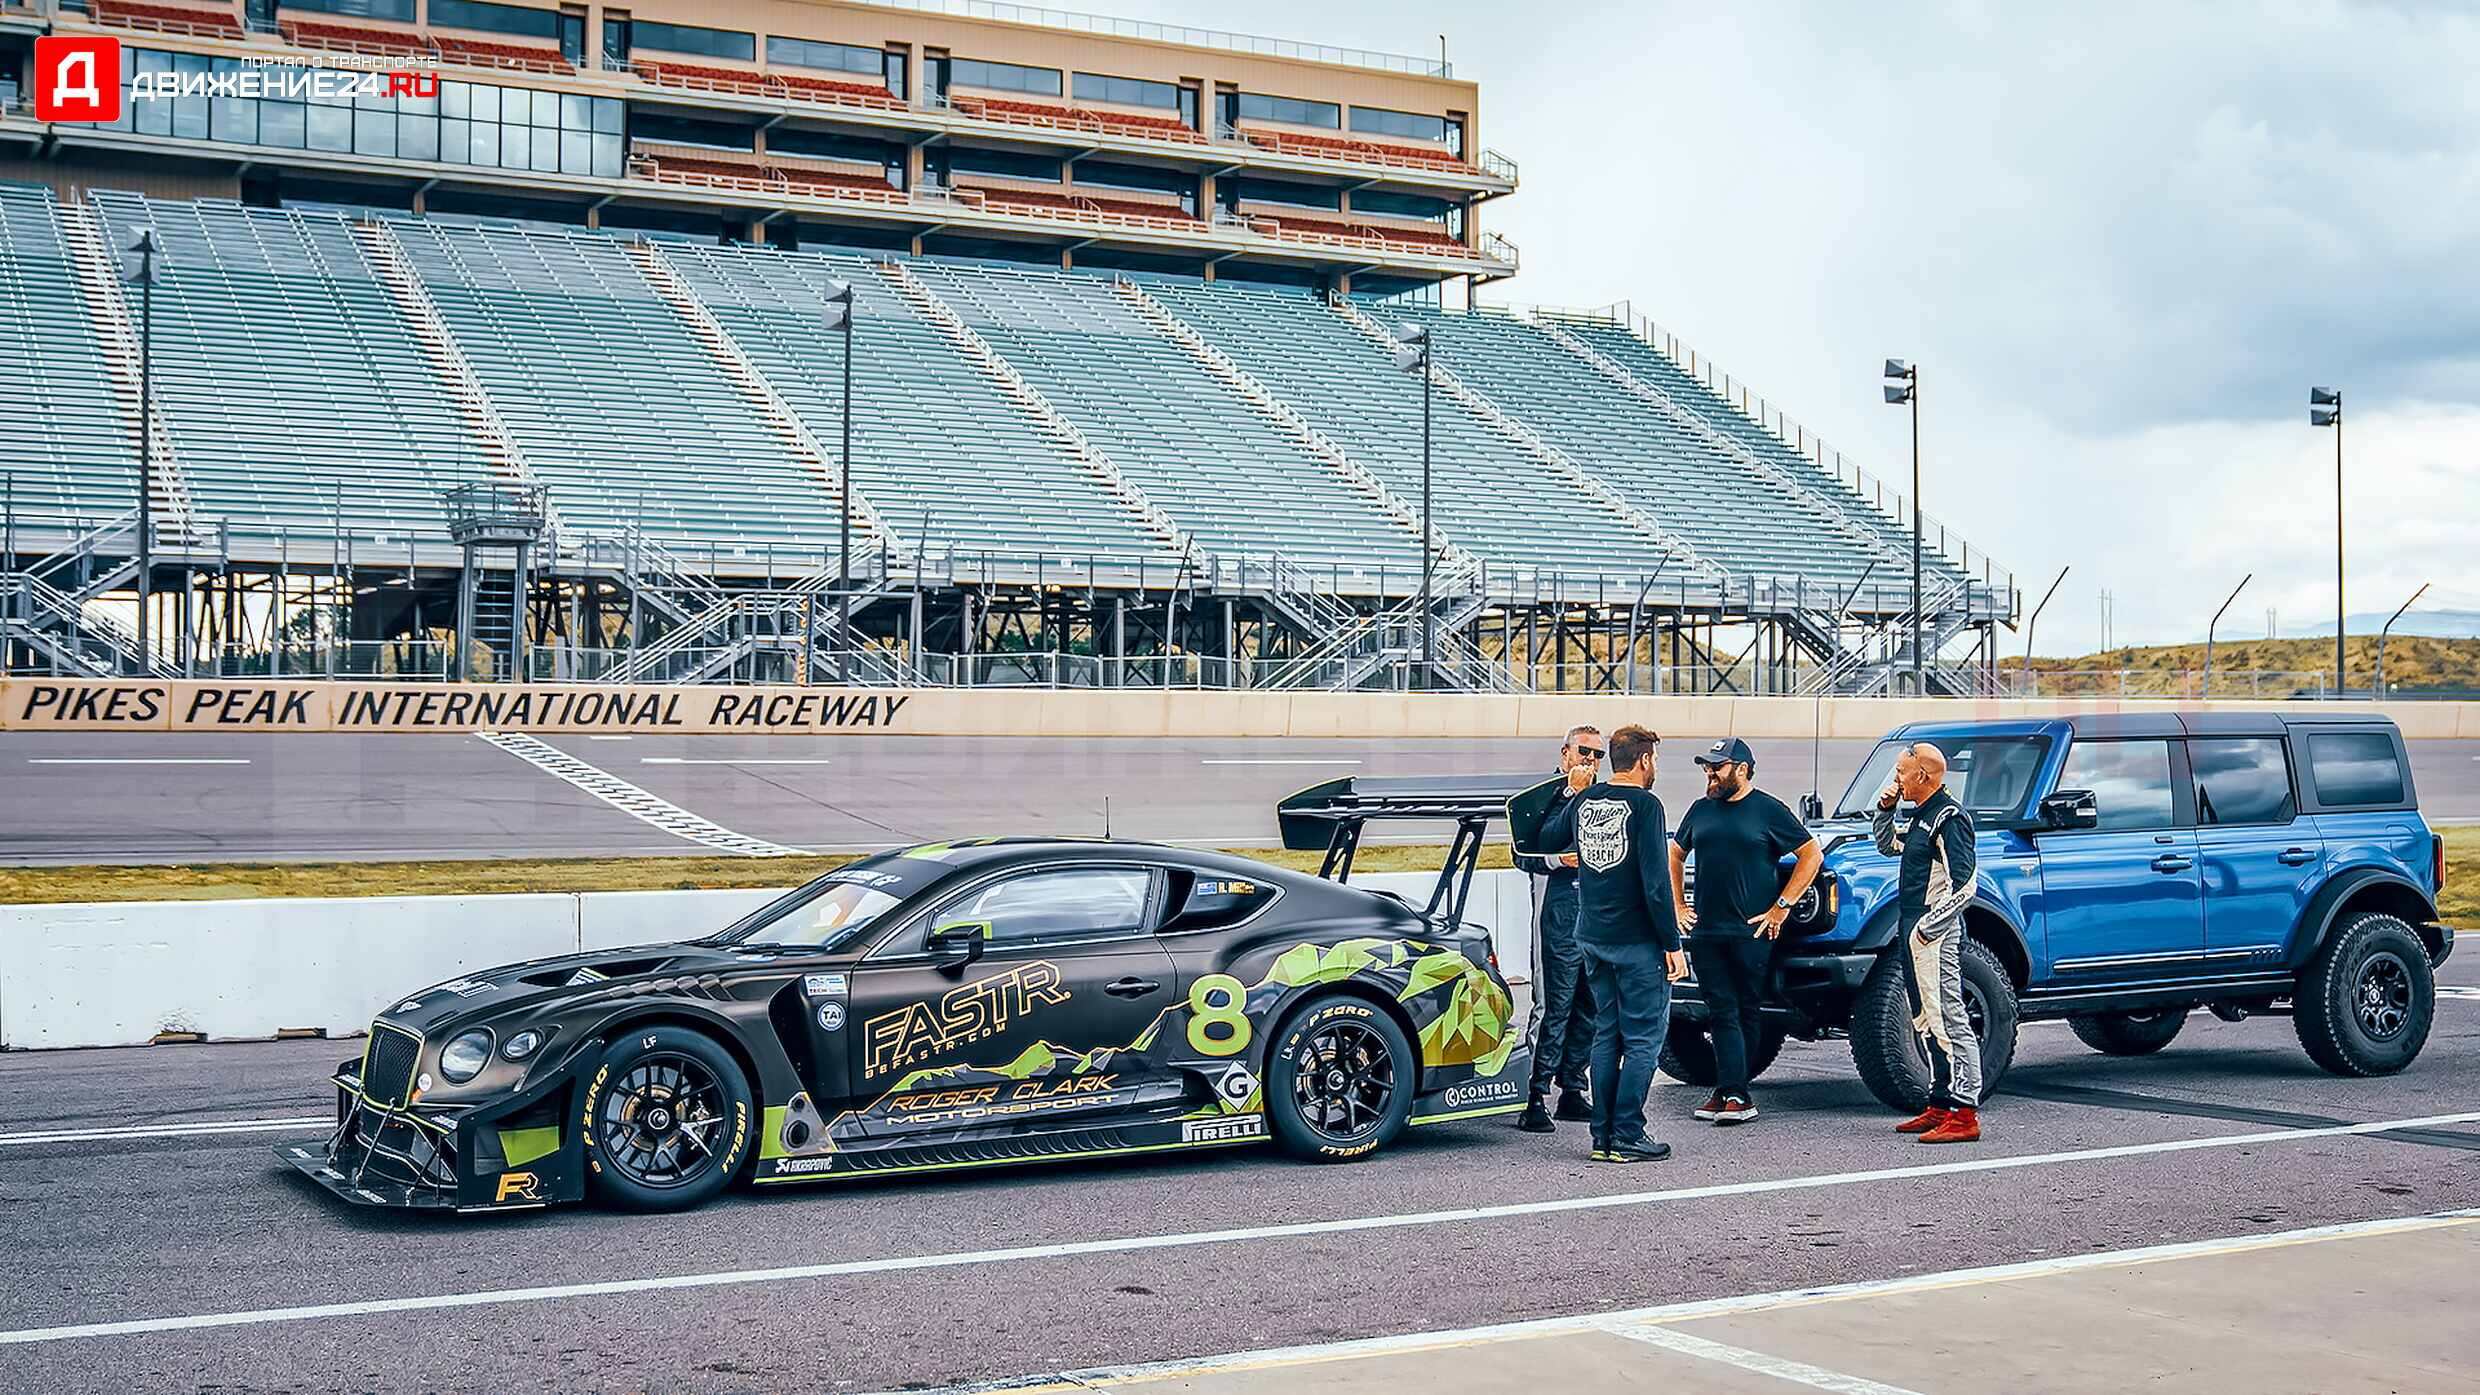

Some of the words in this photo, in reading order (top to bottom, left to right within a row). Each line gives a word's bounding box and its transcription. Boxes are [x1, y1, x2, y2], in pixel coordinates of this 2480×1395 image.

[21, 686, 165, 721] PIKES
[185, 688, 315, 724] PEAK
[337, 690, 684, 726] INTERNATIONAL
[708, 694, 910, 727] RACEWAY
[1186, 973, 1253, 1057] 8
[887, 1087, 1000, 1113] ROGER
[1012, 1074, 1120, 1100] CLARK
[1224, 1072, 1249, 1099] G
[1459, 1081, 1518, 1099] CONTROL
[886, 1094, 1120, 1125] MOTORSPORT
[1182, 1114, 1262, 1142] PIRELLI
